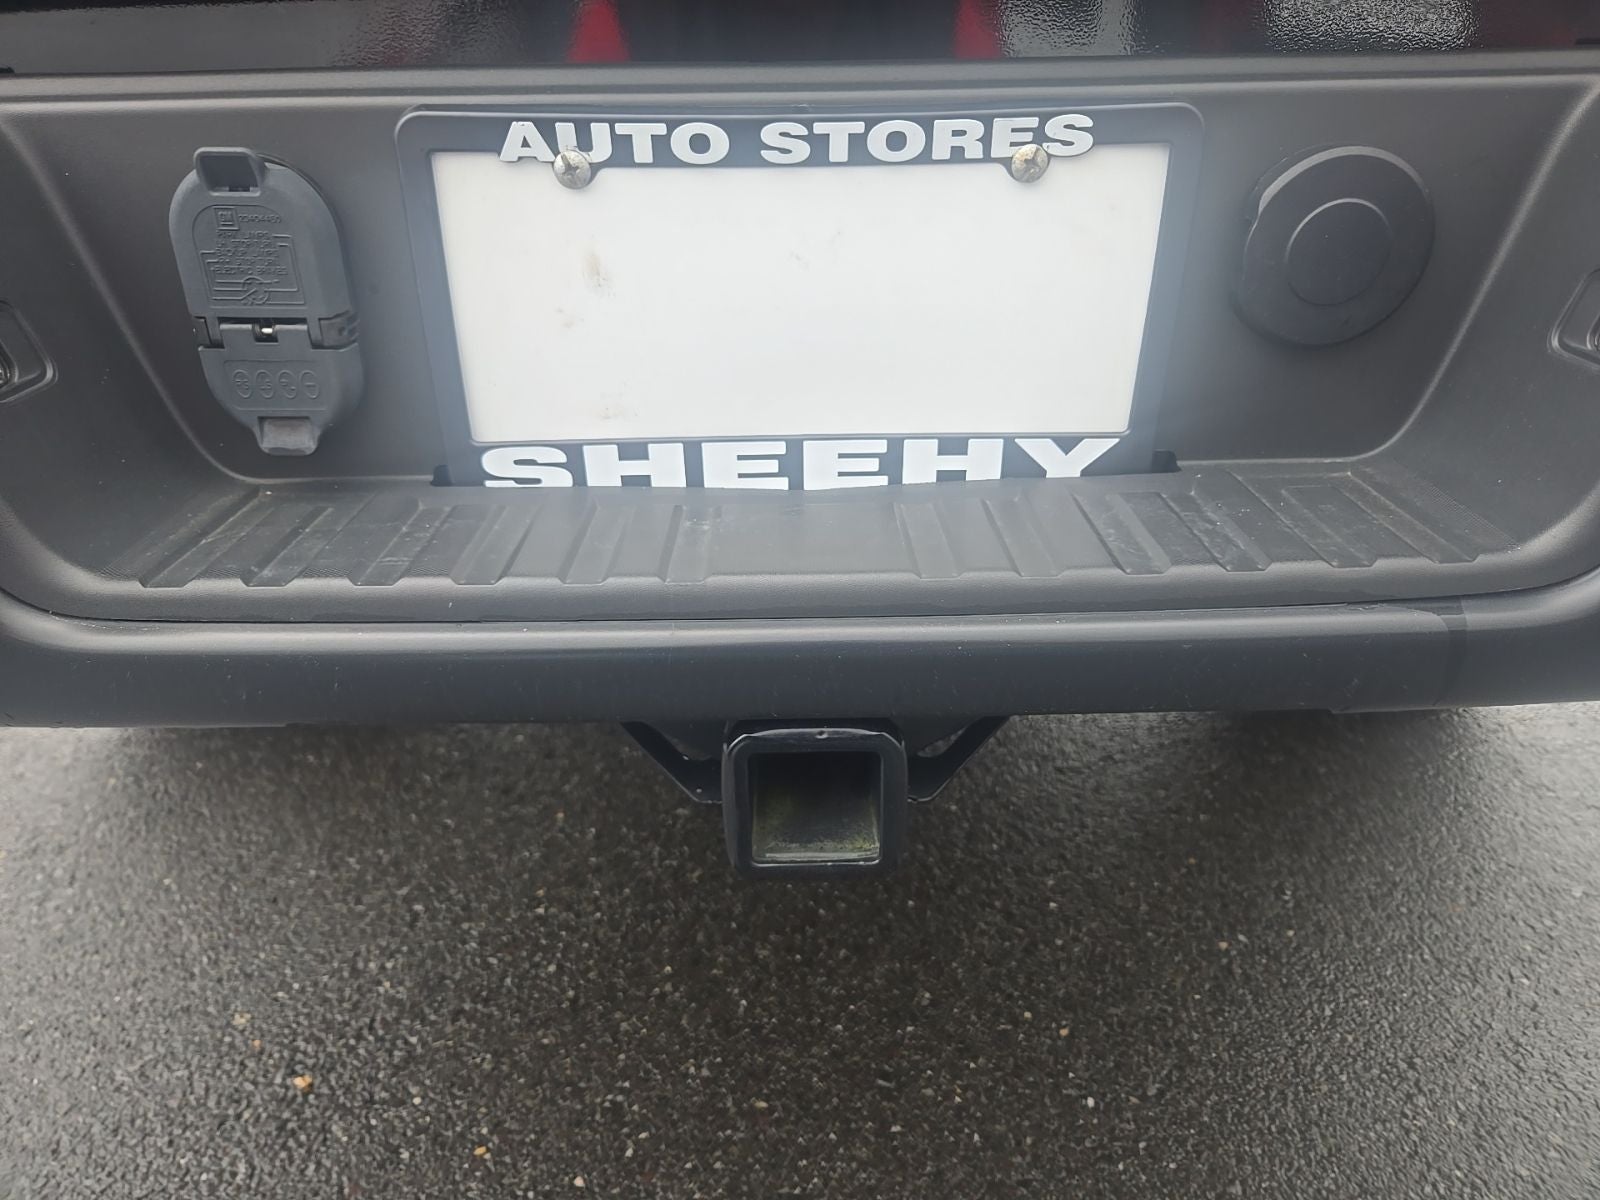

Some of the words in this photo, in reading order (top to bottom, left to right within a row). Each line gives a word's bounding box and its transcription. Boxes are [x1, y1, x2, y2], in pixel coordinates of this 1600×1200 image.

[499, 121, 730, 165] AUTO
[760, 113, 1094, 164] STORES
[483, 438, 1121, 491] SHEEHY
